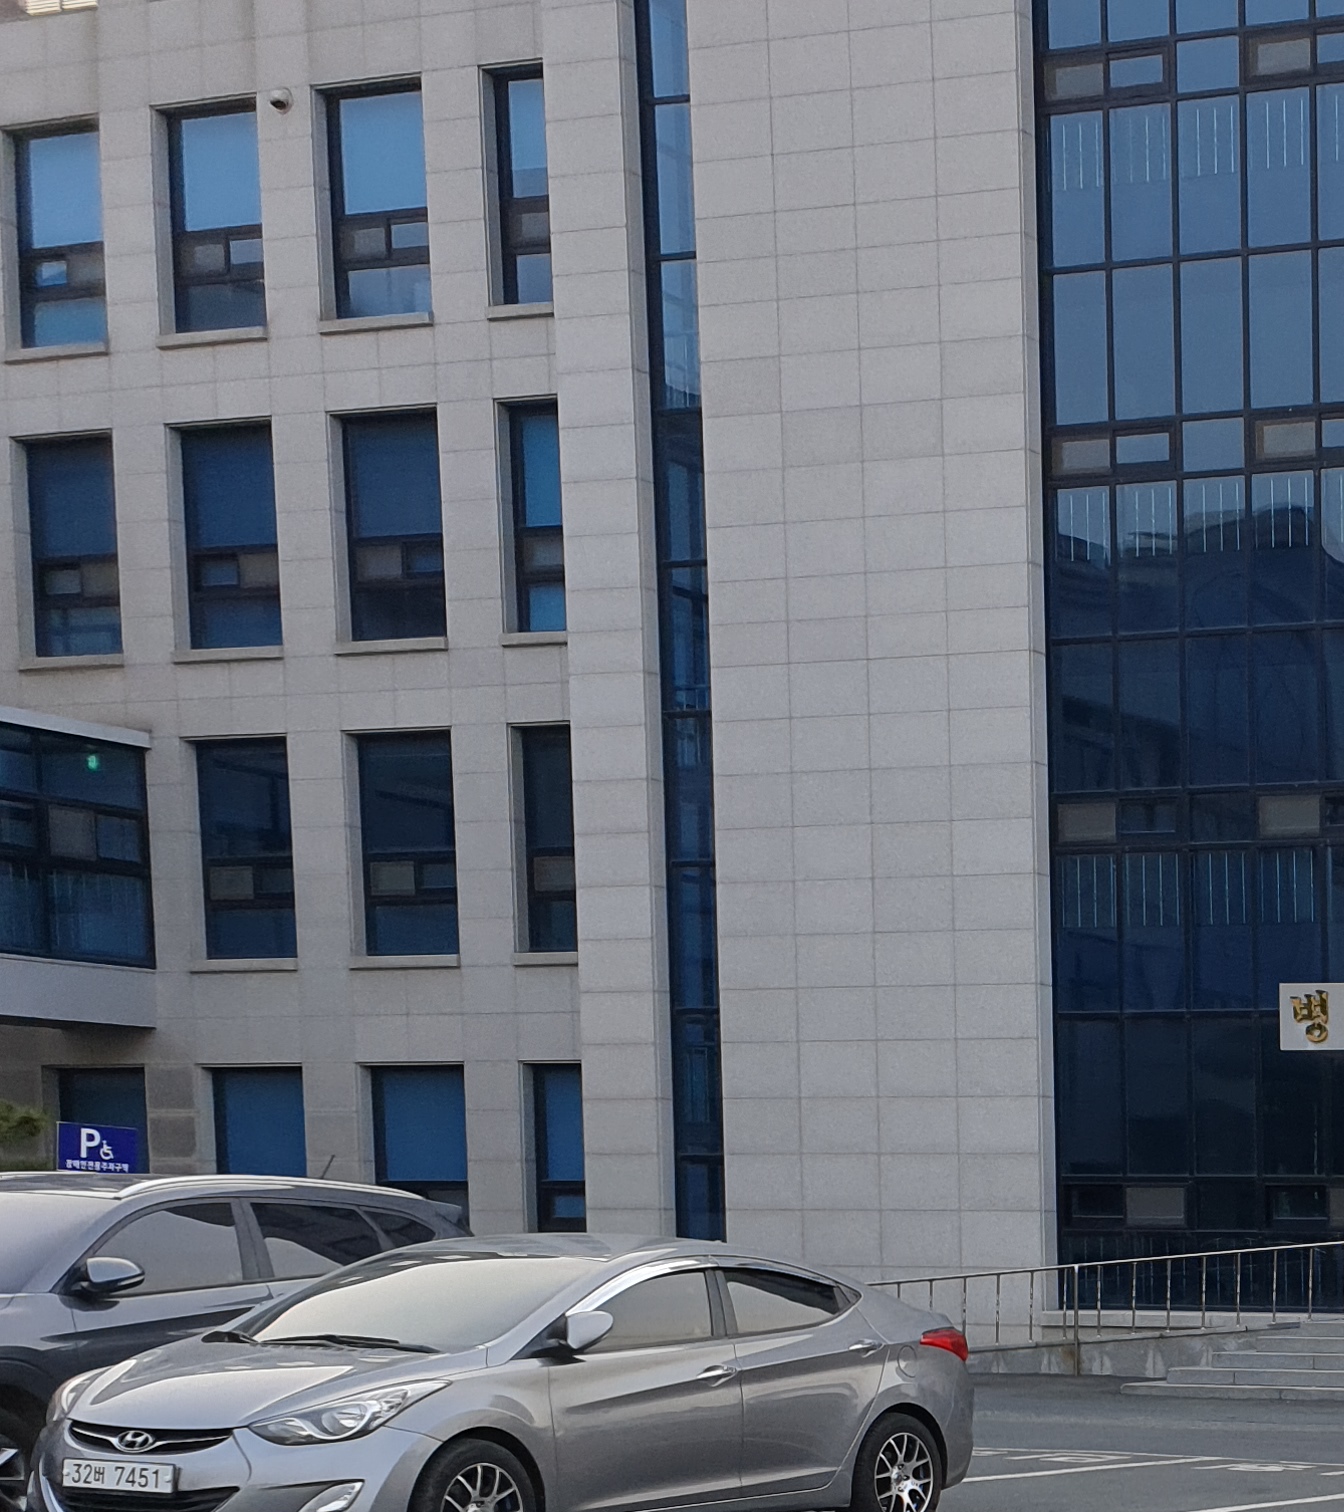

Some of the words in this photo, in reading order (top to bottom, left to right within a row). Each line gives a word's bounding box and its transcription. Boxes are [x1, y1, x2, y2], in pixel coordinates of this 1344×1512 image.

[80, 1127, 101, 1158] P
[71, 1463, 105, 1485] 32버
[114, 1466, 160, 1489] 7451
